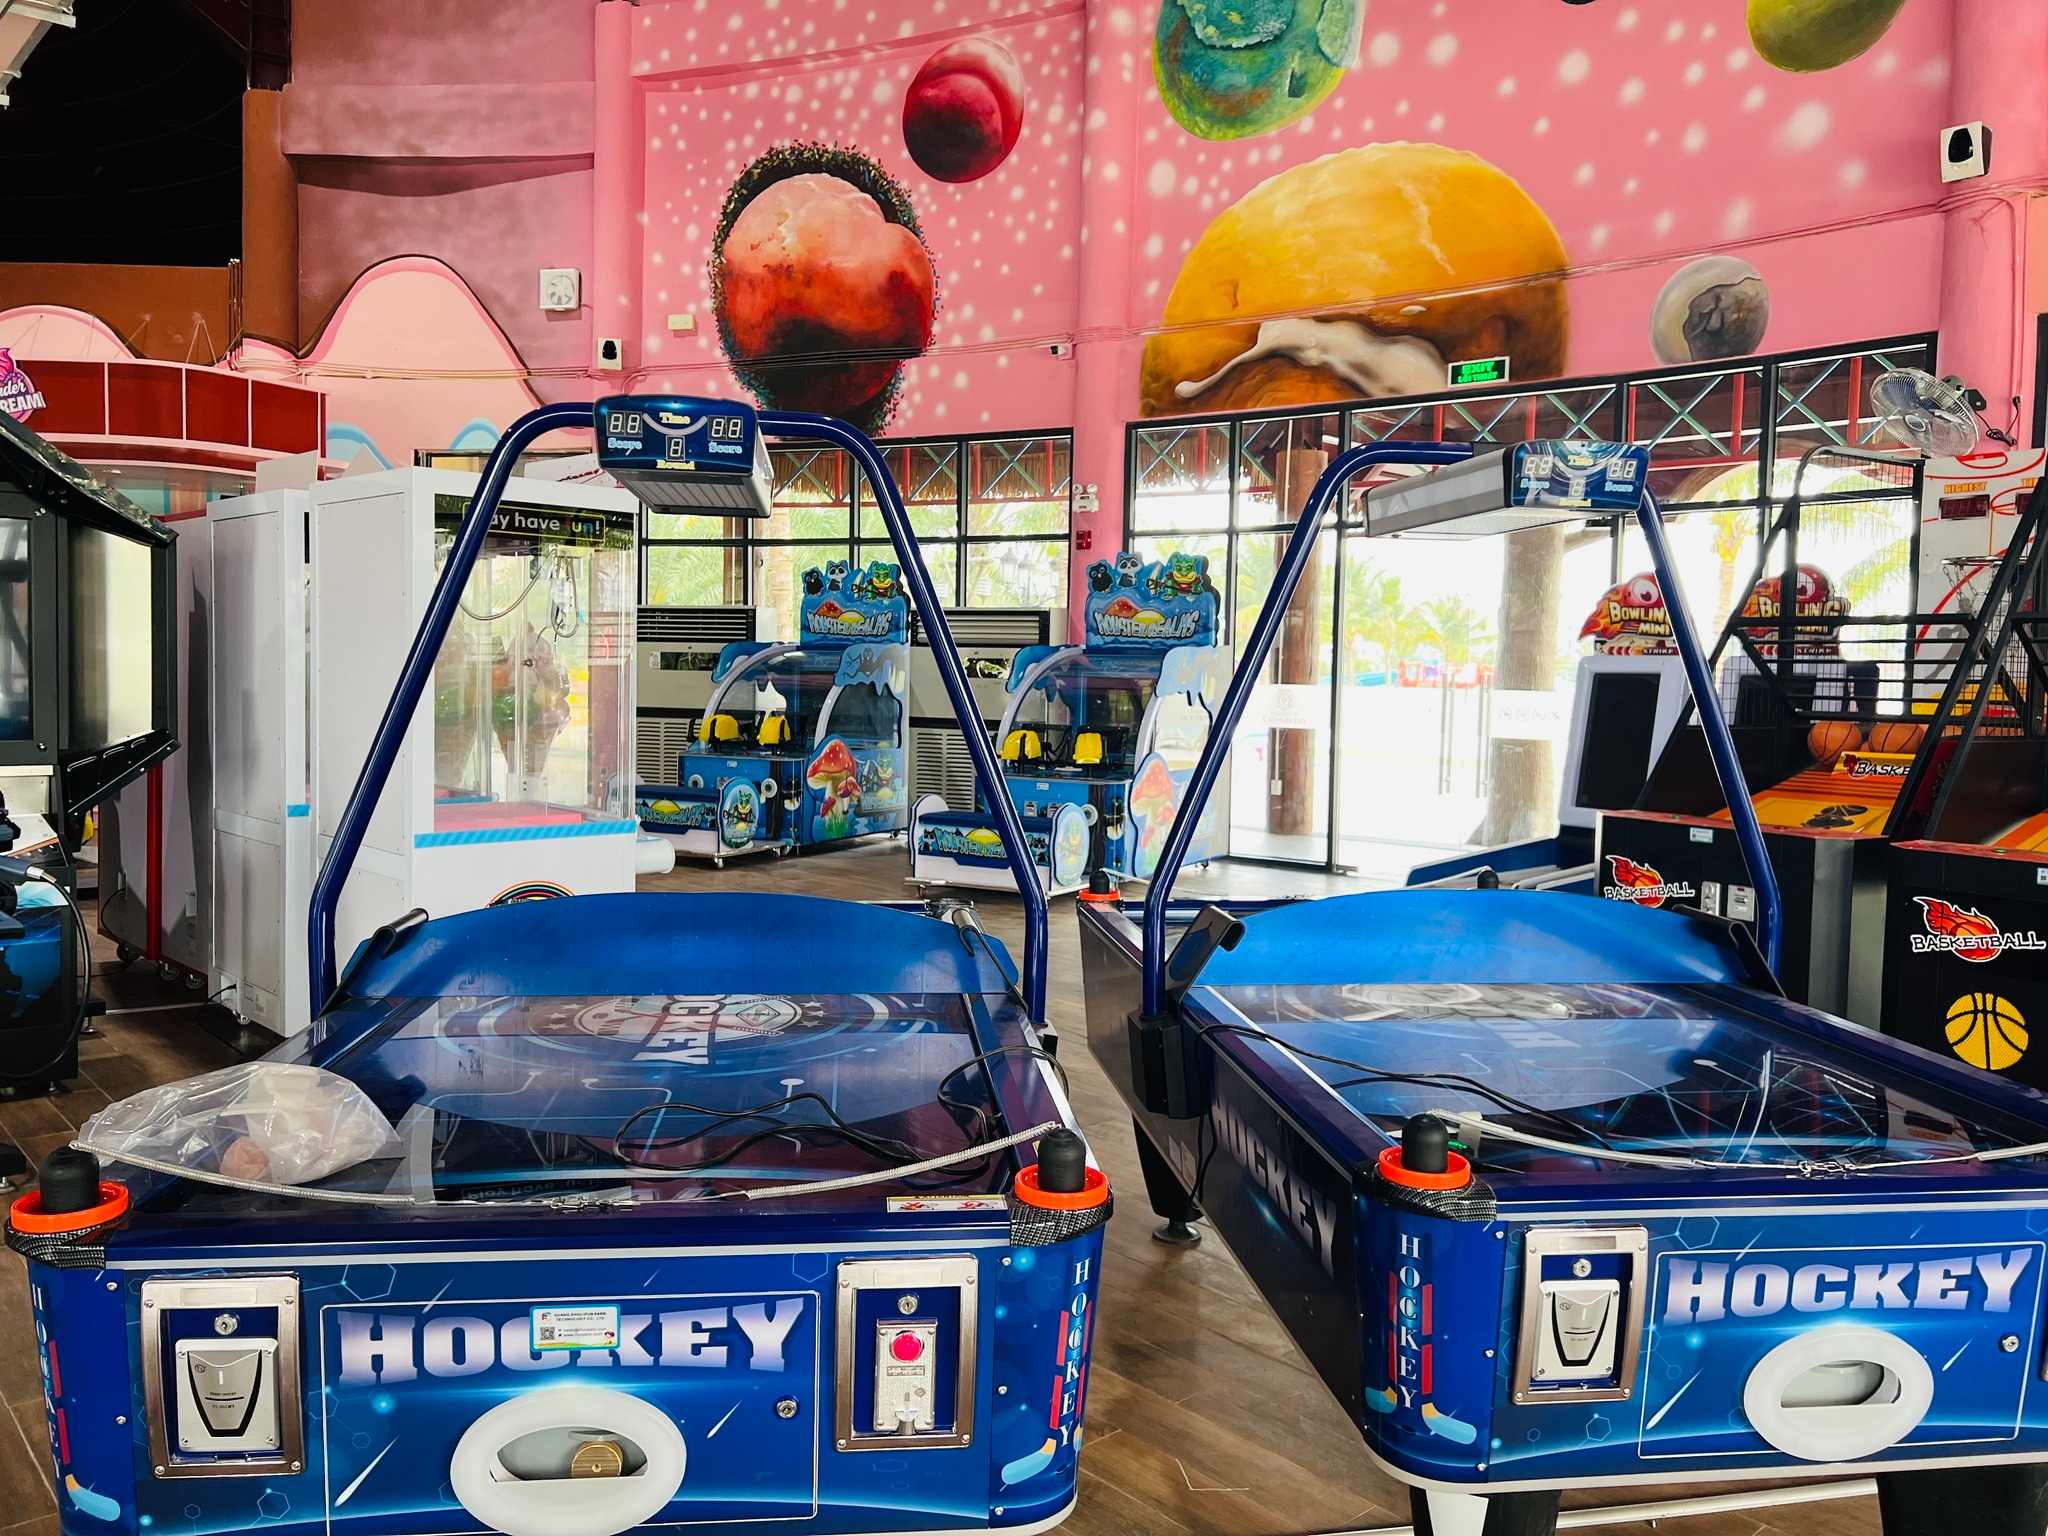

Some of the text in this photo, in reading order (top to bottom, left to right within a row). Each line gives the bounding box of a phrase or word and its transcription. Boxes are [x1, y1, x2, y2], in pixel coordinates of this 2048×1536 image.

[659, 411, 691, 424] Time
[490, 510, 510, 530] ay
[514, 511, 561, 531] have
[1609, 600, 1669, 623] BOWLIN
[1758, 596, 1843, 616] BOLING
[1638, 622, 1670, 636] MINI
[1855, 760, 1911, 777] BASKE
[1604, 881, 1696, 900] BASKETBALL
[1909, 931, 2047, 953] BASKETBALL
[631, 995, 734, 1065] CKEY
[1211, 1094, 1338, 1281] HOCKEY
[1663, 1247, 2034, 1327] HOCKEY
[1399, 1233, 1423, 1411] HOCKEY
[1059, 1256, 1093, 1448] HOCKEY
